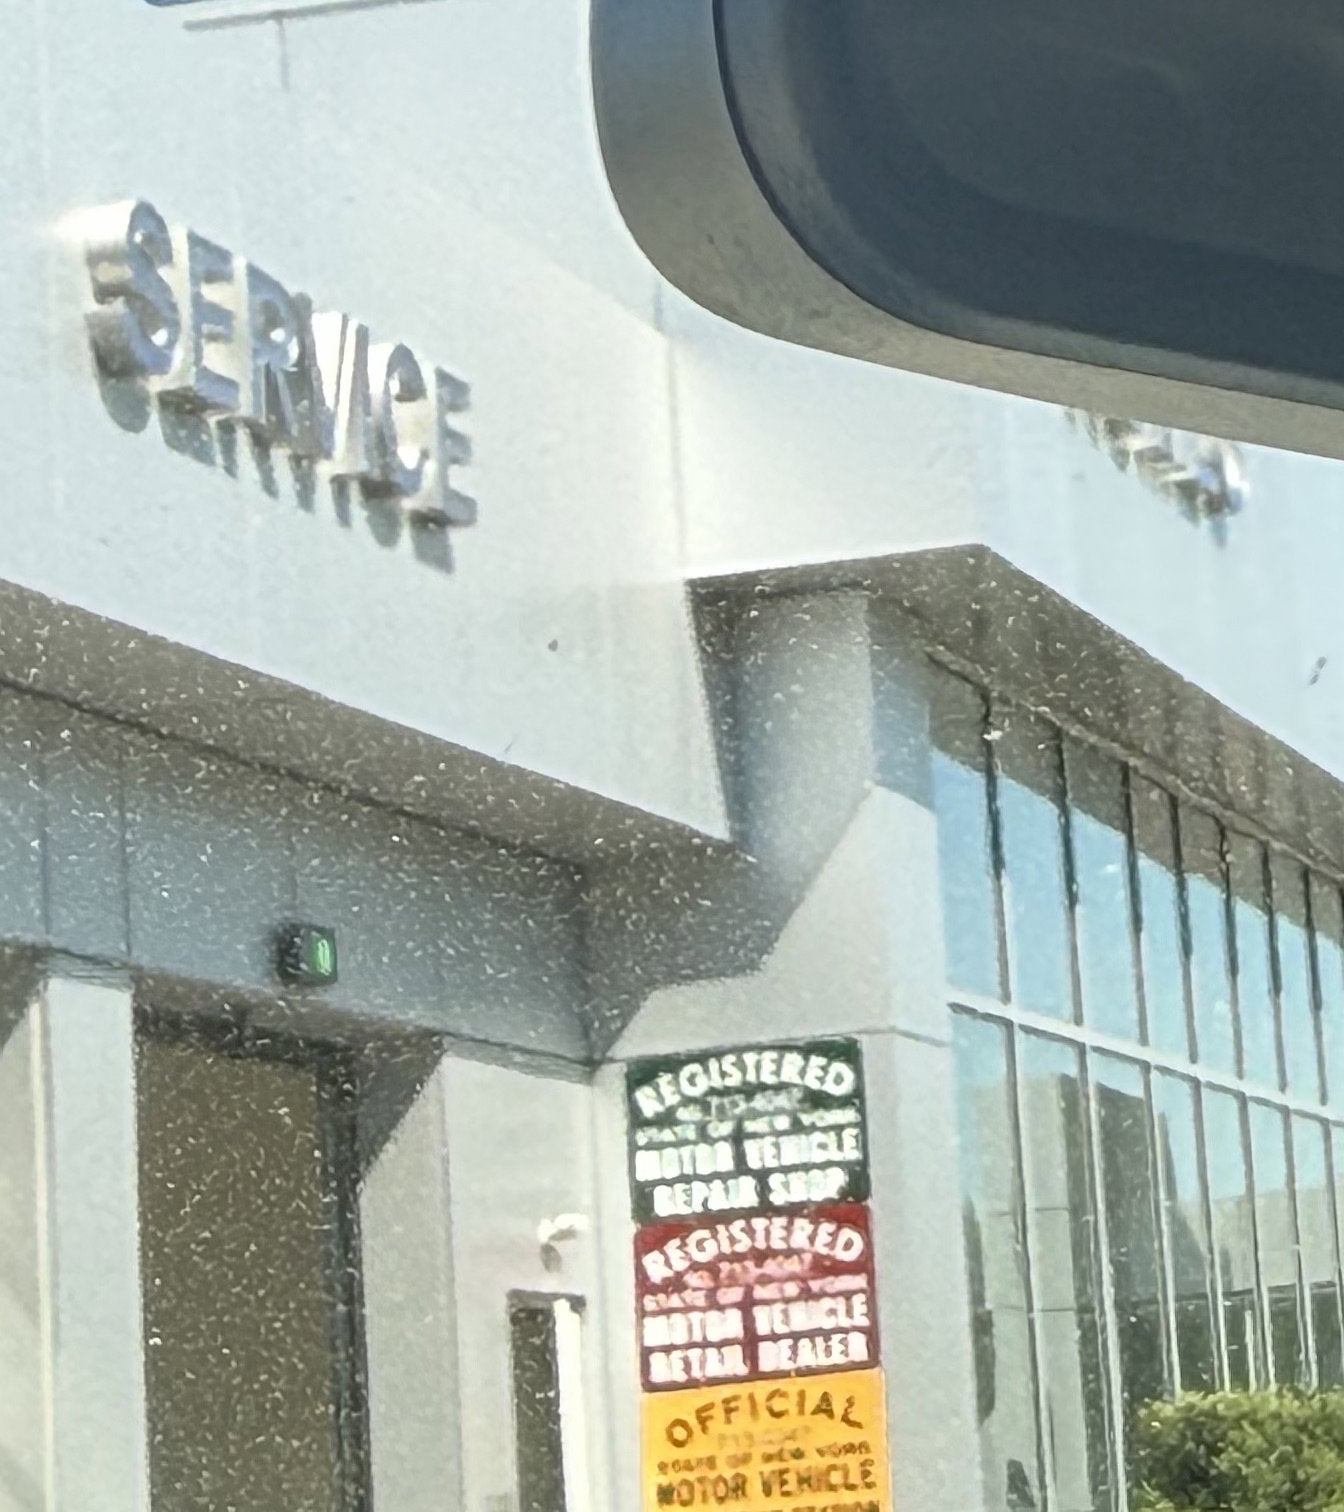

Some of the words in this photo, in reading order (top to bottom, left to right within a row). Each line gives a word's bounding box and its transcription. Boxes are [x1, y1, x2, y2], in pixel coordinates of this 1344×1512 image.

[82, 198, 478, 530] SERVICE
[634, 1049, 856, 1118] REGISTERED
[642, 1217, 864, 1283] REGISTERED
[753, 1293, 869, 1336] VEHICLE
[758, 1331, 868, 1372] DEALER
[665, 1388, 863, 1448] OFFICIAL
[657, 1472, 747, 1507] MOTOR
[759, 1459, 877, 1497] VEHICLE
